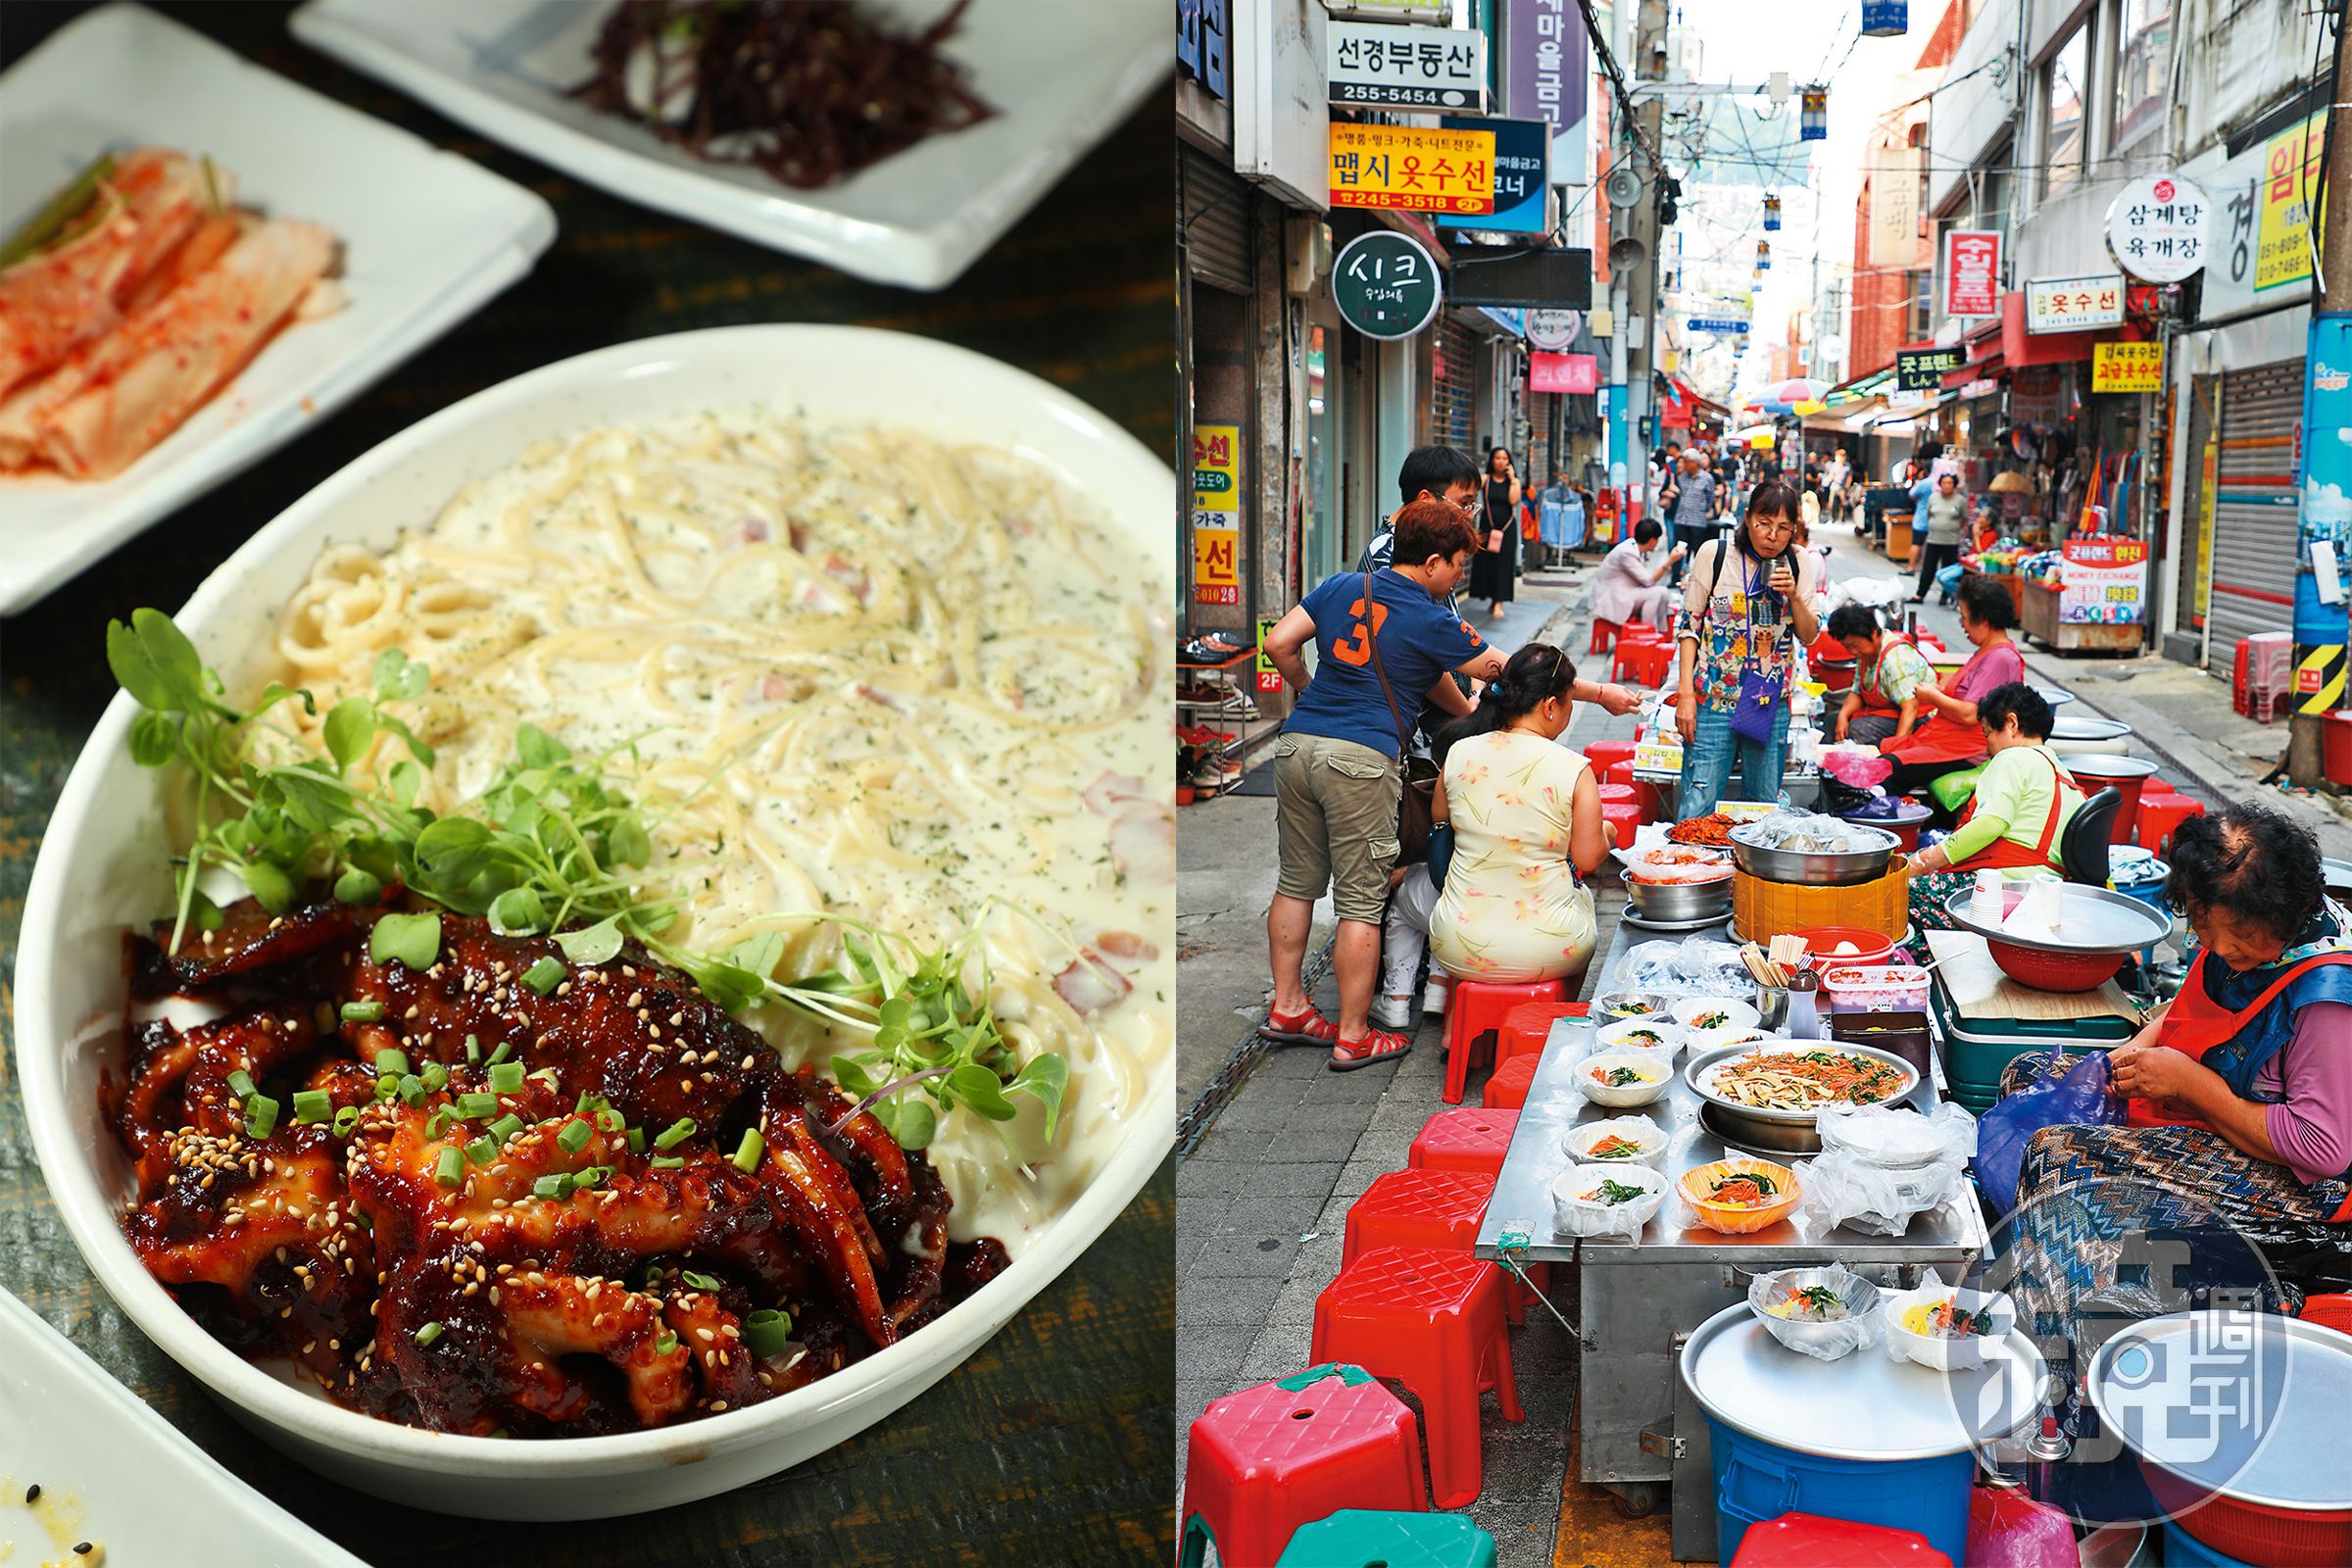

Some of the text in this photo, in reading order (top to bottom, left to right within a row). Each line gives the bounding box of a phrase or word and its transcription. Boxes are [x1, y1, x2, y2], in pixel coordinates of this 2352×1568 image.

[1338, 37, 1474, 78] 선경부동산
[1344, 85, 1438, 104] 255-5454
[1333, 152, 1485, 192] 맵시 옷수선
[1355, 192, 1447, 209] 245-3518
[2126, 204, 2203, 226] 삼계탕
[2125, 237, 2202, 259] 육개장
[1348, 253, 1421, 287] 시크
[2051, 289, 2115, 314] 옷수선
[1333, 598, 1389, 666] 3
[1460, 621, 1483, 647] 3
[1261, 673, 1281, 689] 2F
